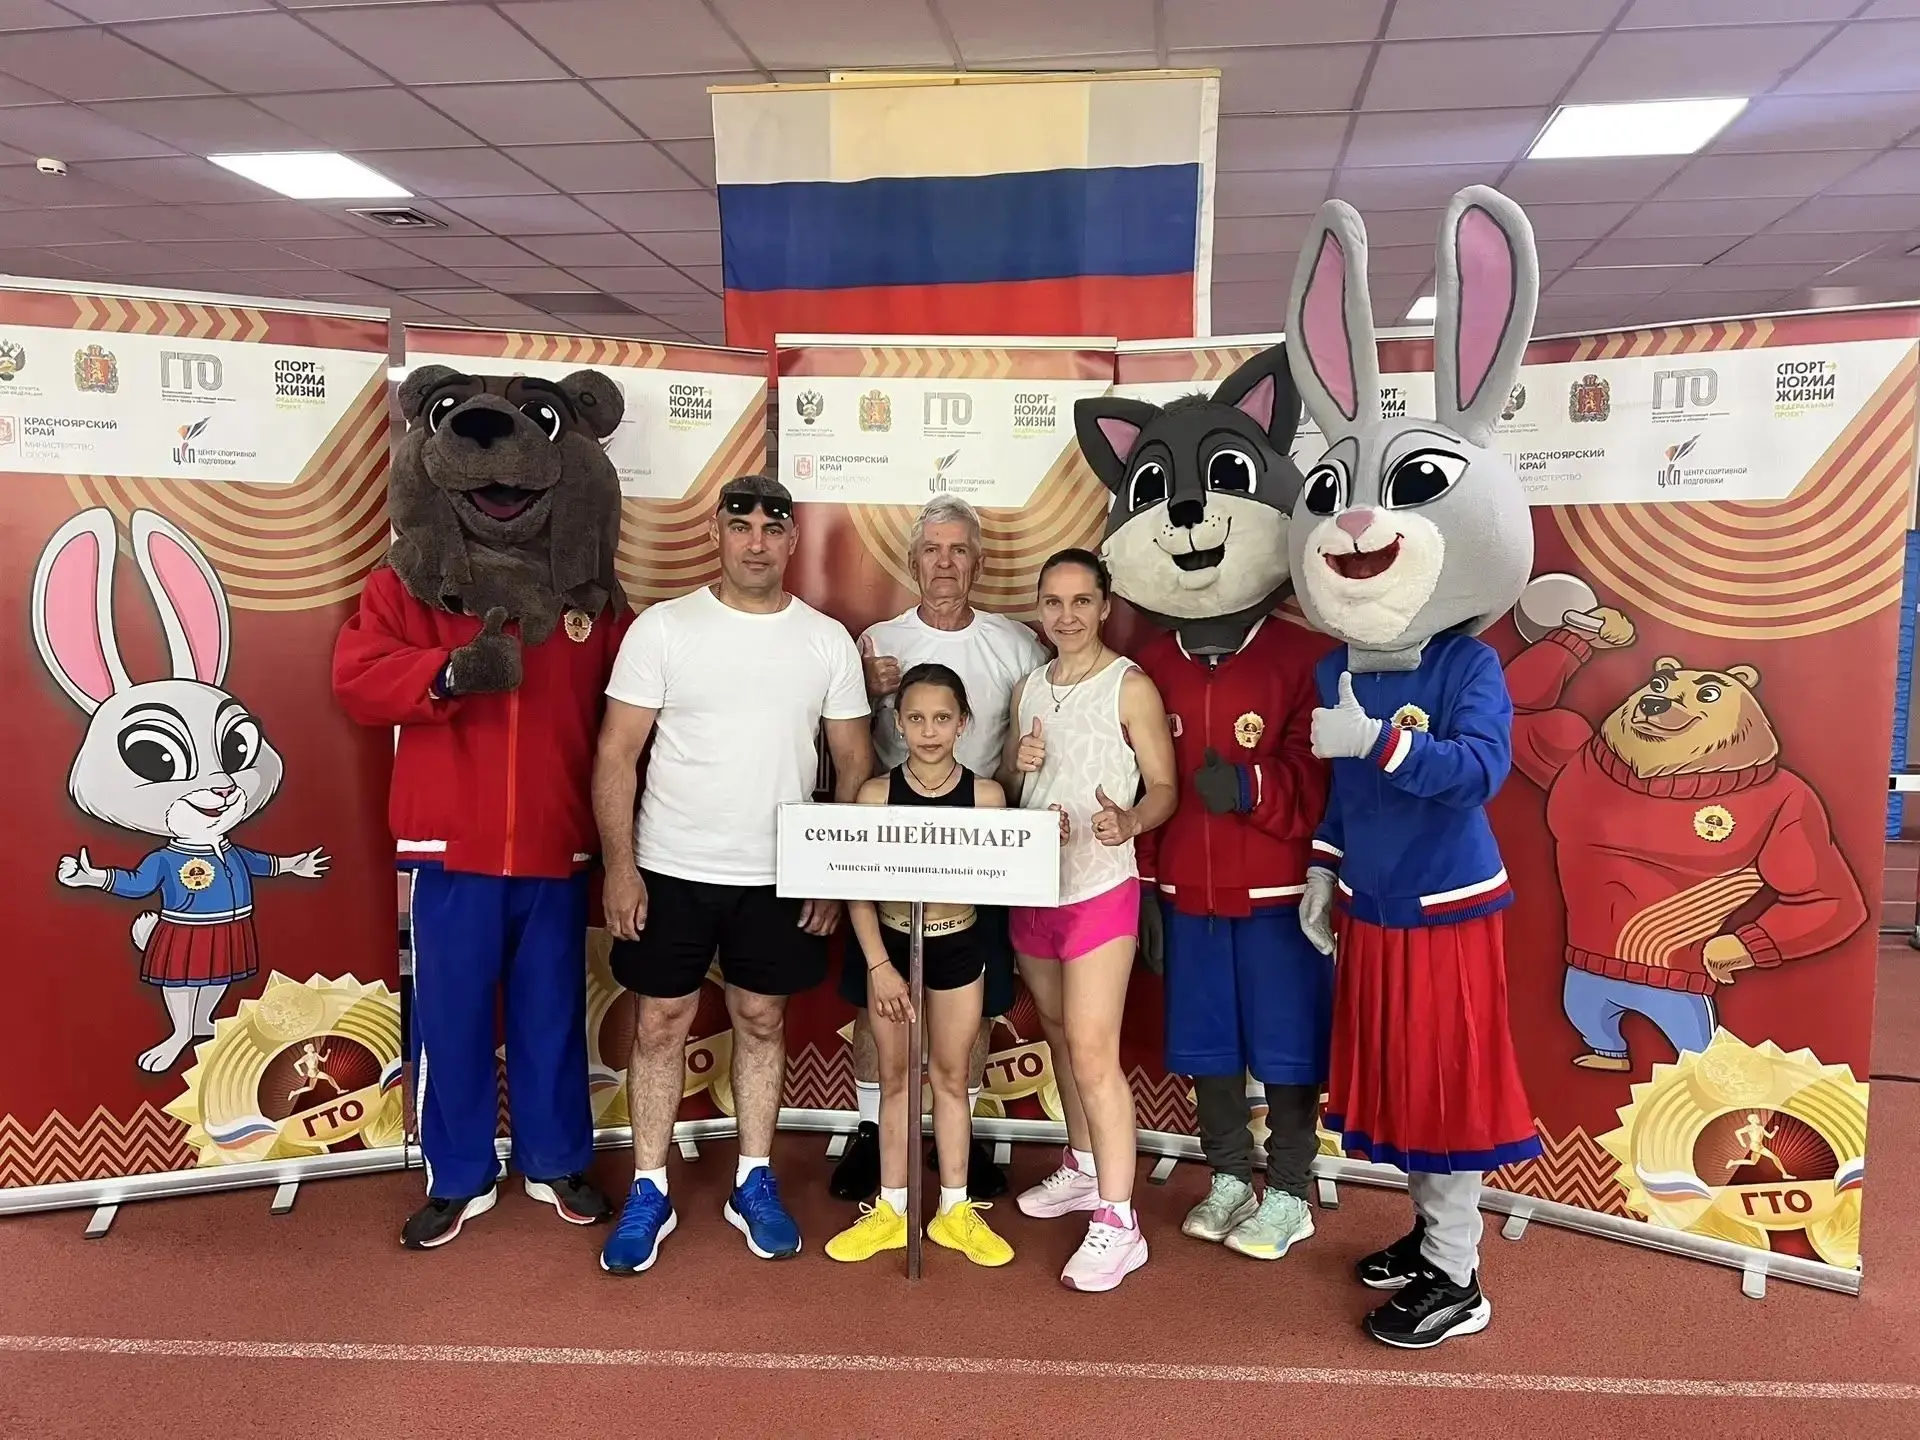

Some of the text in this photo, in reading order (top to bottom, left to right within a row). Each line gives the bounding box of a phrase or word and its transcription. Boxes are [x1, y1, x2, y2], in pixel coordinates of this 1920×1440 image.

[160, 351, 222, 391] ГТО
[274, 360, 316, 373] СПОРТ
[1776, 360, 1826, 375] СПОРТ
[275, 372, 325, 386] НОРМА
[1776, 373, 1836, 389] НОРМА
[275, 384, 325, 398] ЖИЗНИ
[669, 384, 705, 397] СПОРТ
[1652, 368, 1718, 410] ГТО
[1775, 387, 1835, 402] ЖИЗНИ
[669, 395, 712, 409] НОРМА
[1014, 393, 1050, 405] СПОРТ
[669, 407, 712, 420] ЖИЗНИ
[923, 392, 973, 425] ГТО
[1014, 404, 1056, 416] НОРМА
[24, 416, 118, 430] КРАСНОЯРСКИЙ
[1014, 415, 1056, 427] ЖИЗНИ
[24, 426, 55, 437] КРАЙ
[819, 454, 889, 464] КРАСНОЯРСКИЙ
[1519, 447, 1606, 461] КРАСНОЯРСКИЙ
[819, 462, 842, 471] КРАЙ
[1519, 459, 1547, 471] КРАЙ
[1683, 467, 1748, 476] ЦЕНТР СПОРТИВНОЙ
[804, 821, 1033, 849] семья ШЕЙНМАЕР
[826, 860, 1009, 879] Ачинский муниципальный округ
[981, 1052, 1044, 1089] ГТО
[302, 1099, 364, 1138] ГТО
[1740, 1188, 1813, 1216] ГТО
